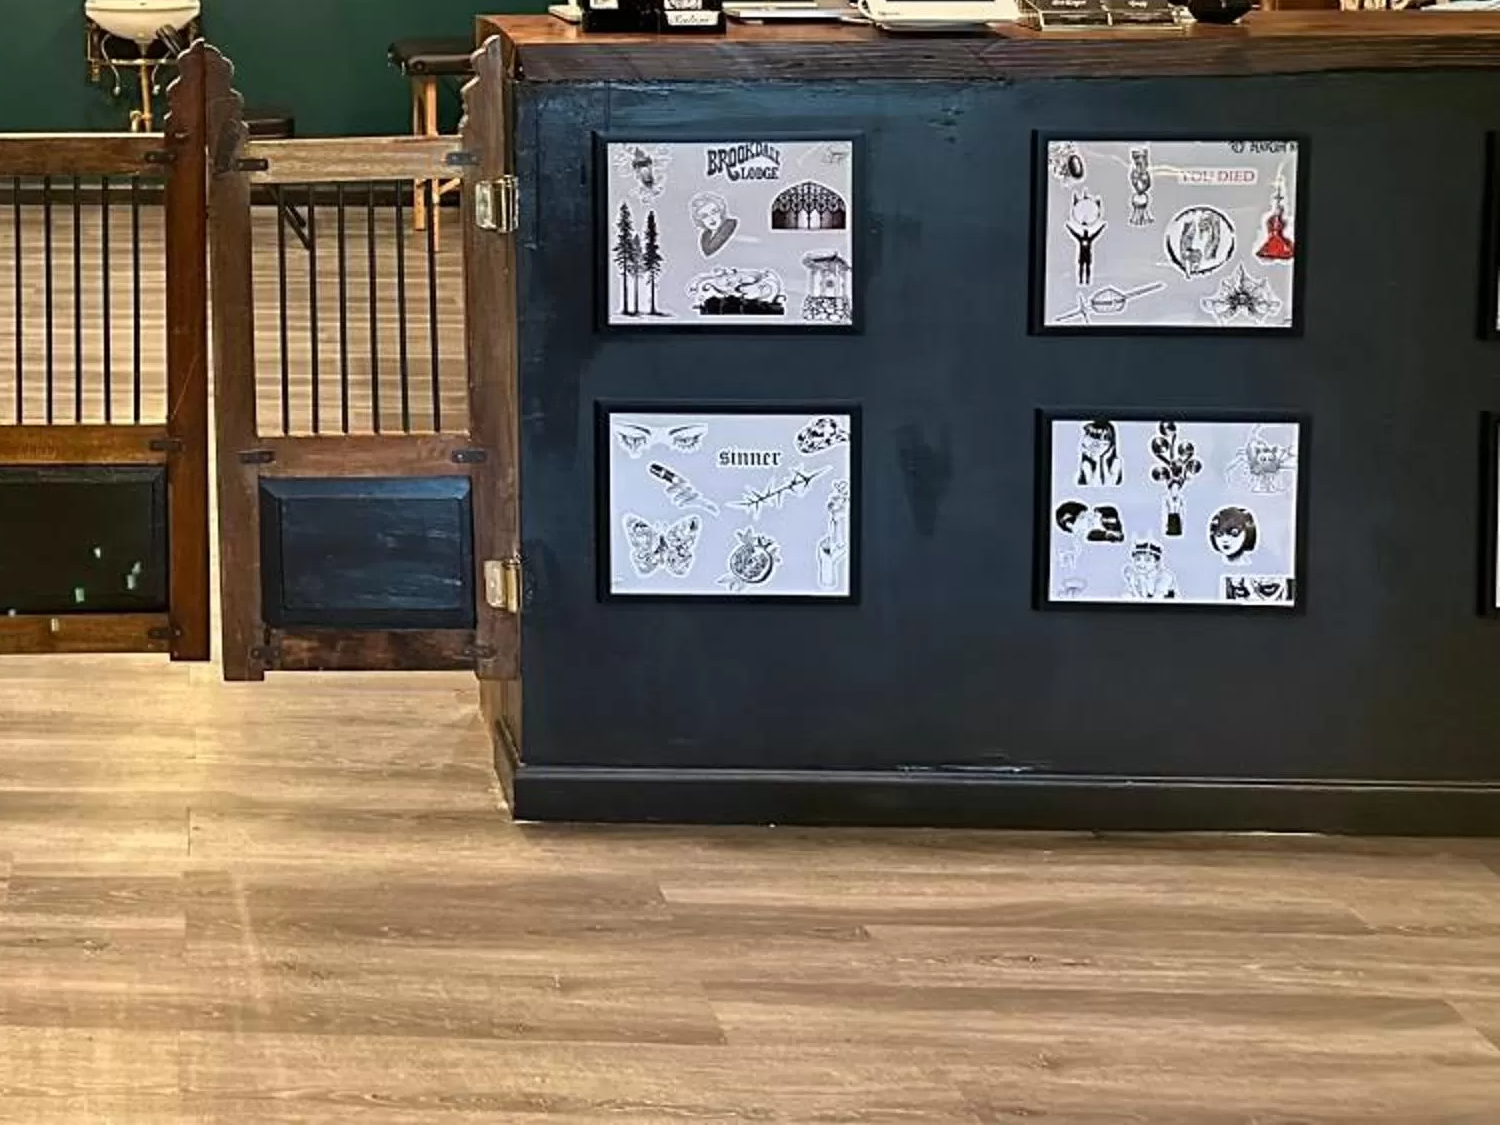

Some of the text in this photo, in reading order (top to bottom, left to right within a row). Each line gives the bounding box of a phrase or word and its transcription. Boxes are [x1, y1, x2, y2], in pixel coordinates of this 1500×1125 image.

[740, 166, 780, 180] LODGE
[1182, 170, 1256, 182] YOU DIED
[718, 449, 782, 467] sinner
